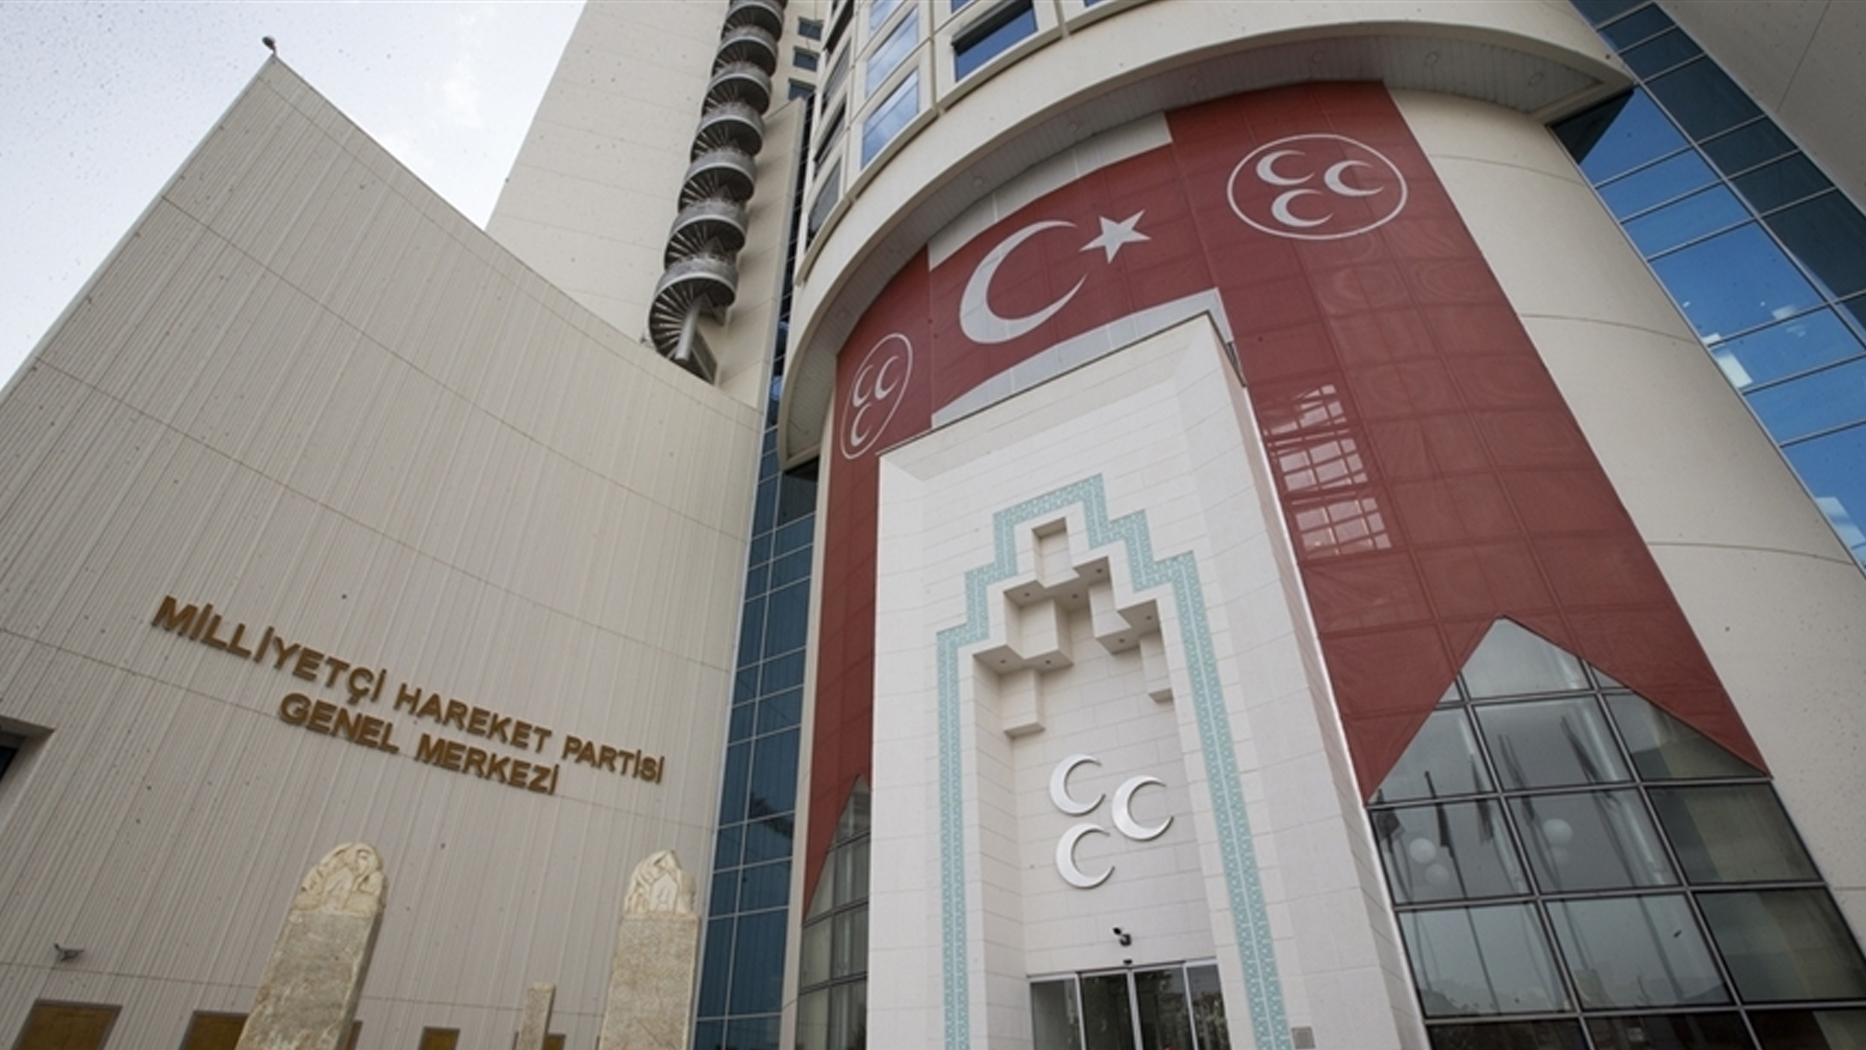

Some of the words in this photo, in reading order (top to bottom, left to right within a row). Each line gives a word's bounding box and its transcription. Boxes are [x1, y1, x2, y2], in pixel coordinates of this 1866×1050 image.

[152, 596, 387, 705] MİLLİYETÇİ
[394, 683, 553, 754] HAREKET
[562, 735, 665, 784] PARTİSİ
[279, 692, 399, 755] GENEL
[415, 733, 560, 795] MERKEZİ
